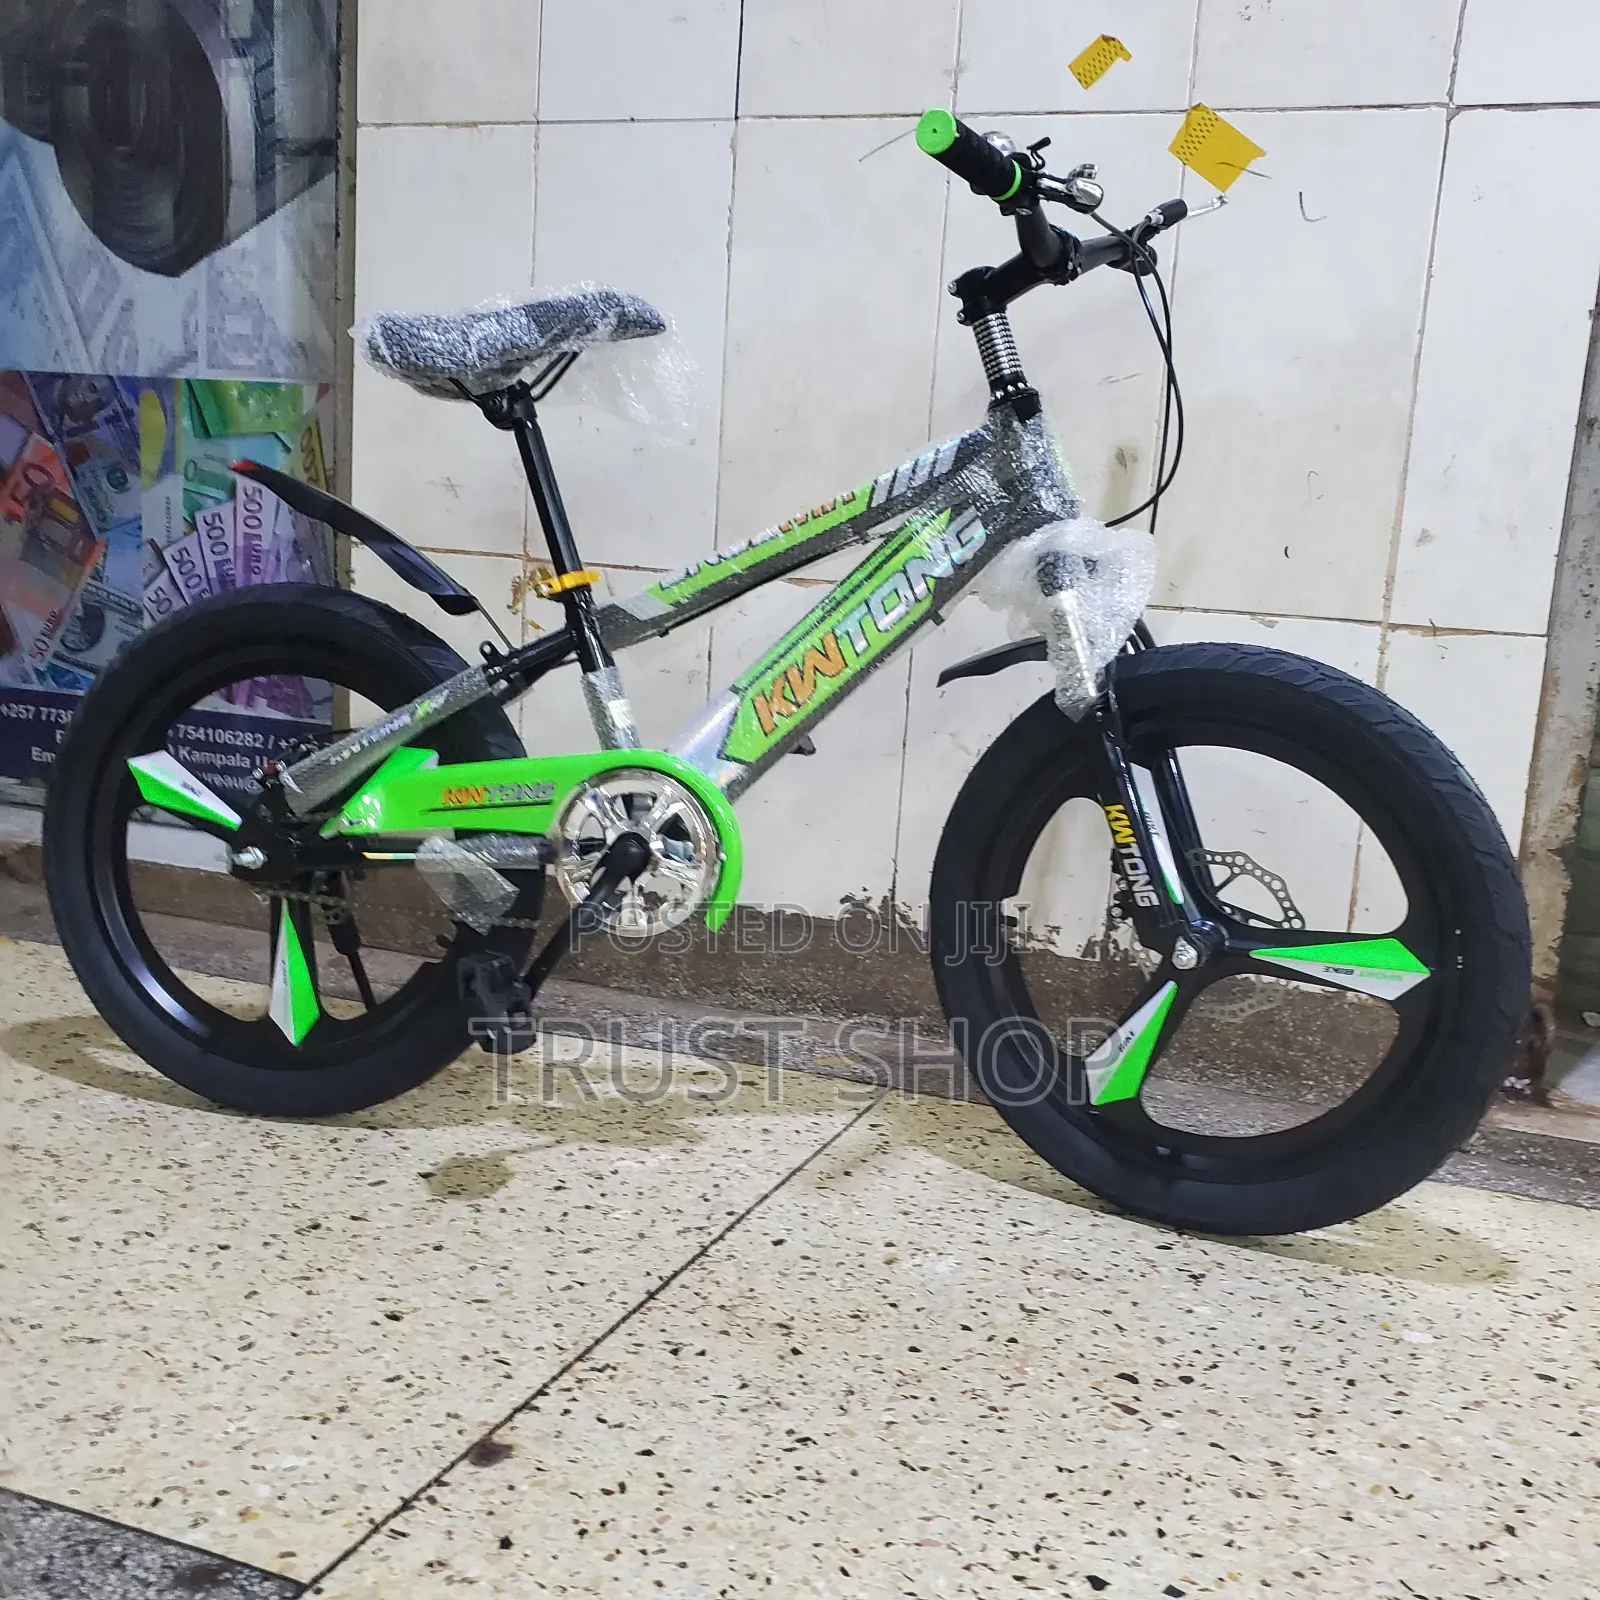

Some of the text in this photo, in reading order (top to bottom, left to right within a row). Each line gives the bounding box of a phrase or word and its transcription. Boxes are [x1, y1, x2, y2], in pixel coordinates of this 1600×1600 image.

[243, 485, 264, 529] 500
[202, 512, 229, 556] 500
[170, 547, 203, 590] 500
[751, 505, 988, 737] KWTONG
[176, 723, 265, 749] 754106282
[177, 744, 251, 769] Kampala
[1104, 804, 1161, 908] KWTONG
